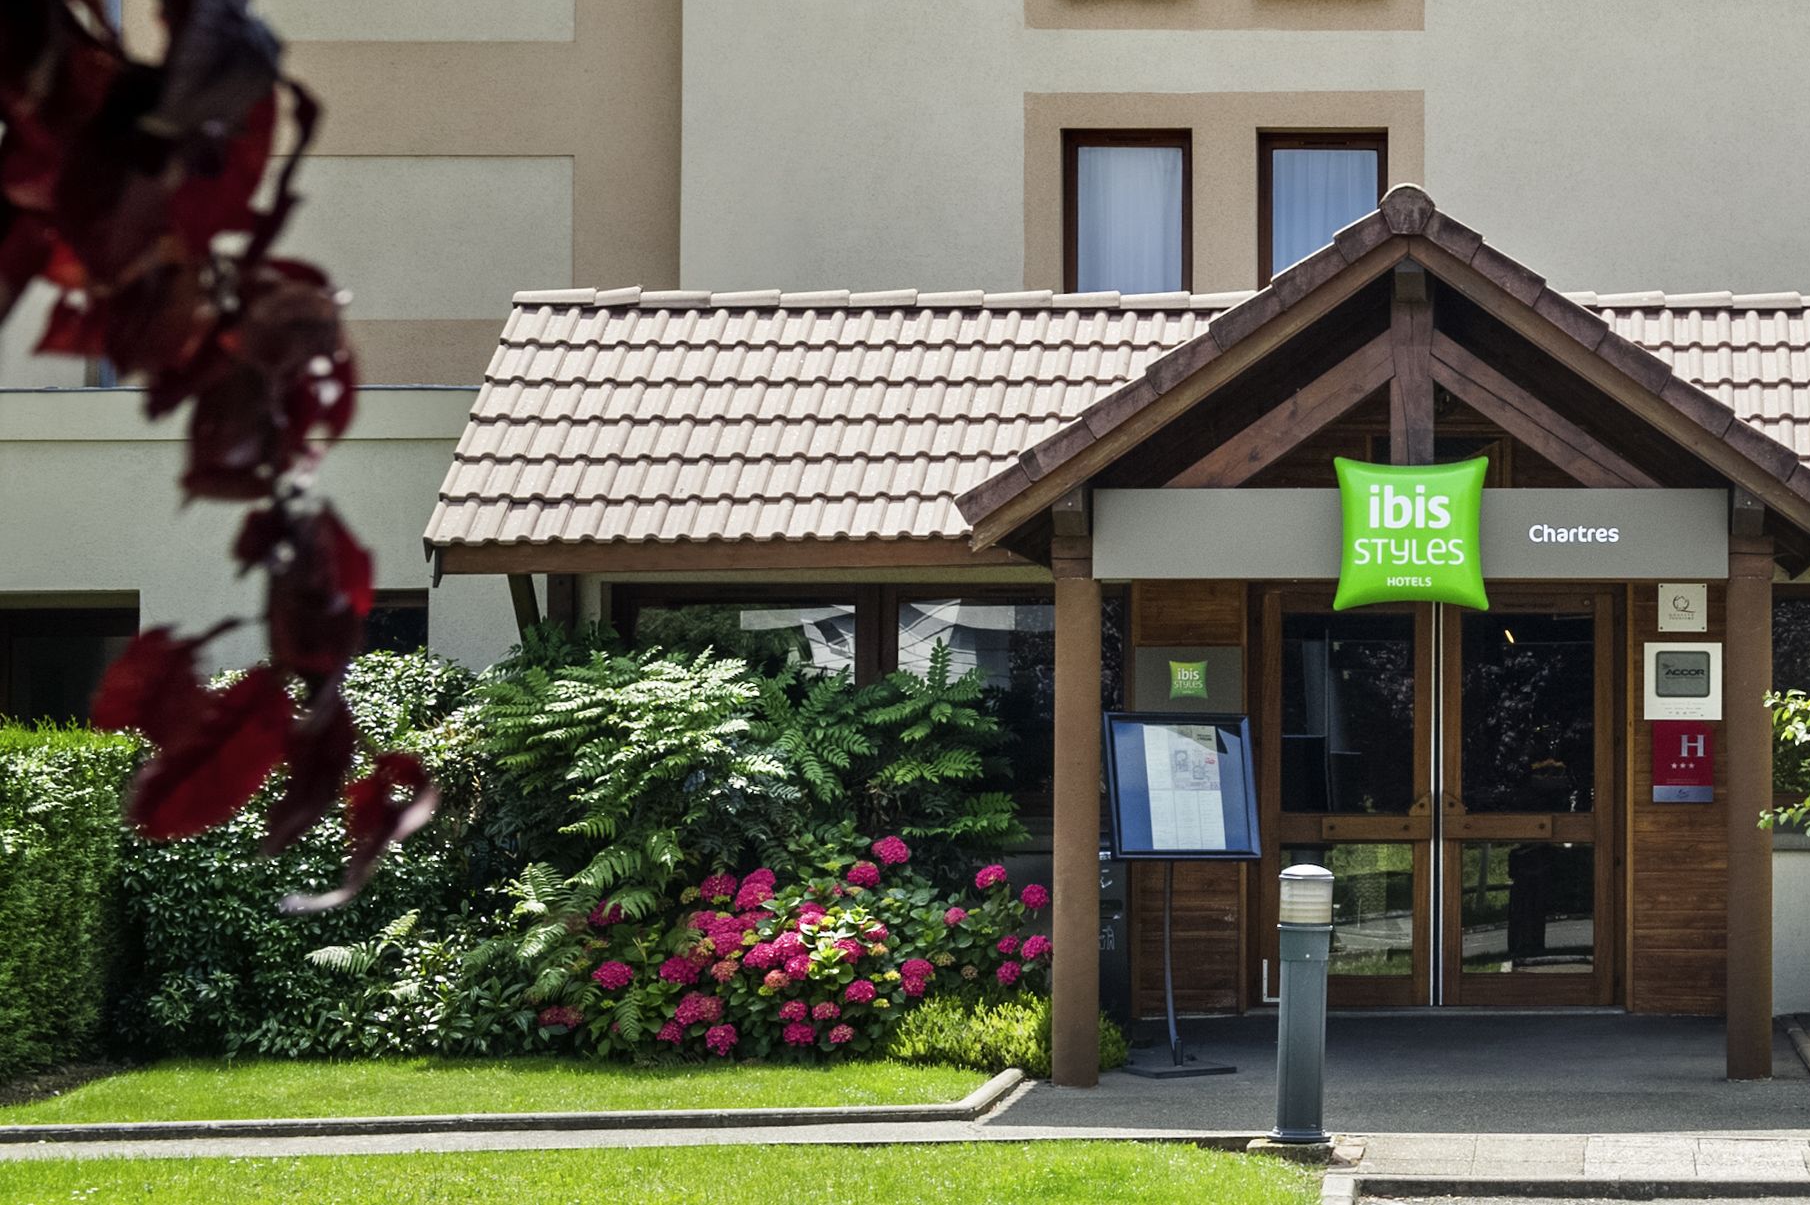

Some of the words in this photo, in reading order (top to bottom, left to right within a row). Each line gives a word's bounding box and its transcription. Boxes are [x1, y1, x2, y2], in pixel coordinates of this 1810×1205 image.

[1369, 484, 1452, 529] ibis
[1528, 524, 1620, 544] Chartres
[1386, 576, 1433, 588] HOTELS
[1177, 667, 1200, 681] ibis
[1665, 668, 1705, 677] ACCOR
[1680, 734, 1705, 757] H
